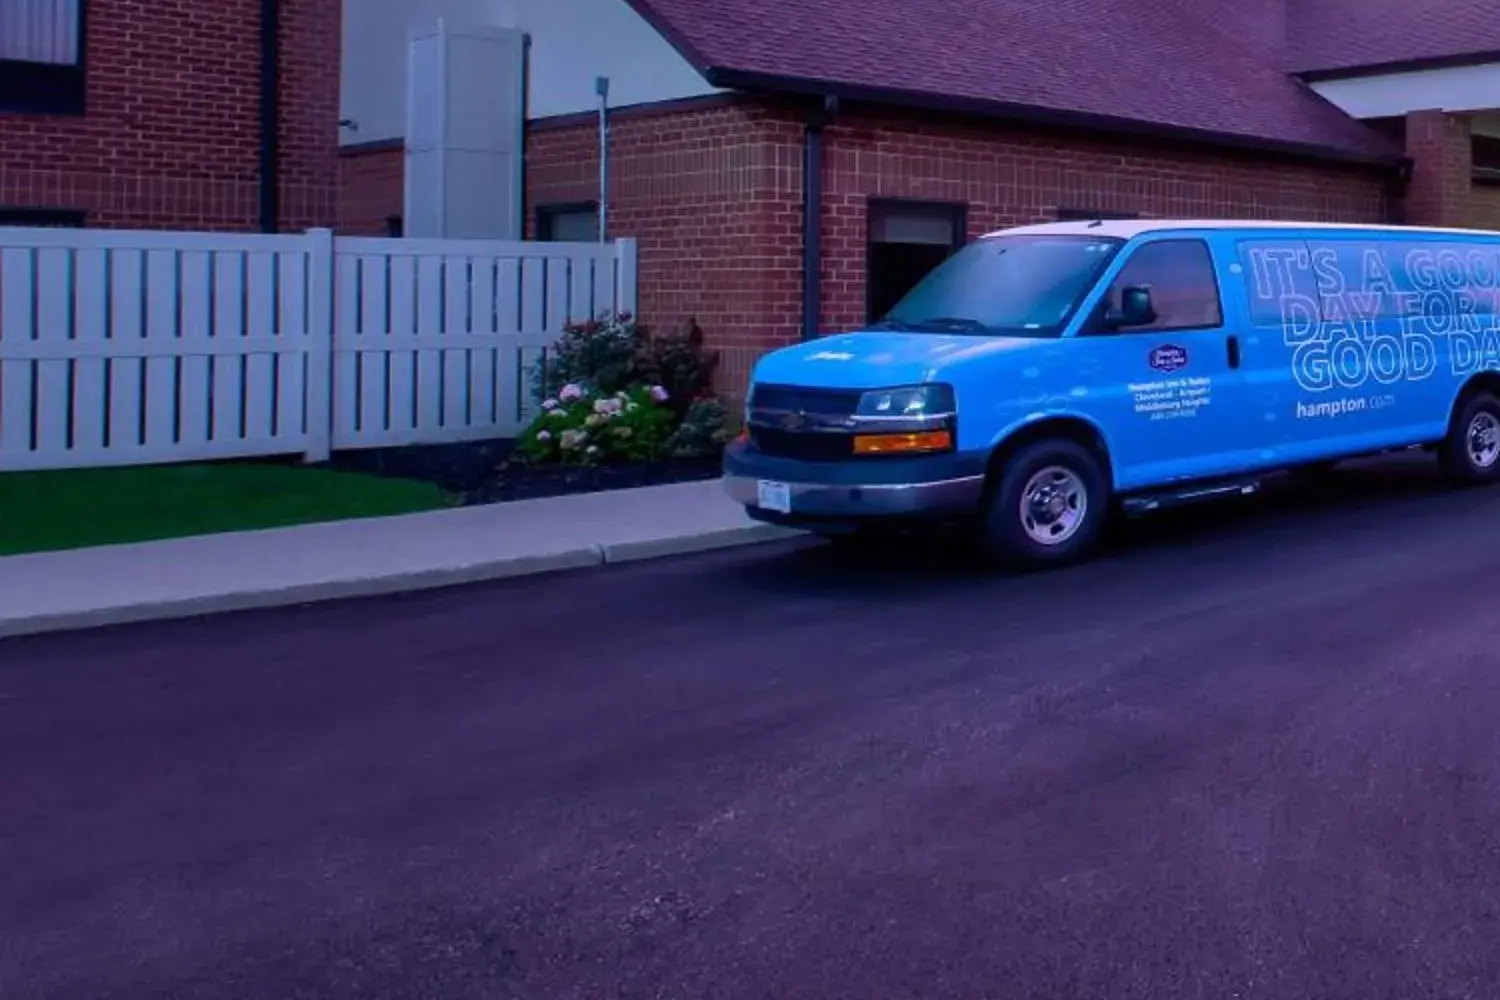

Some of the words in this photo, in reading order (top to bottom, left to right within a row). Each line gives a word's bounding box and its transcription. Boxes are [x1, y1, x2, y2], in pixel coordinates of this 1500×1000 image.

[1249, 248, 1345, 299] IT'S
[1361, 249, 1399, 295] A
[1280, 292, 1382, 346] DAY
[1397, 288, 1482, 336] FOR
[1291, 333, 1437, 391] GOOD
